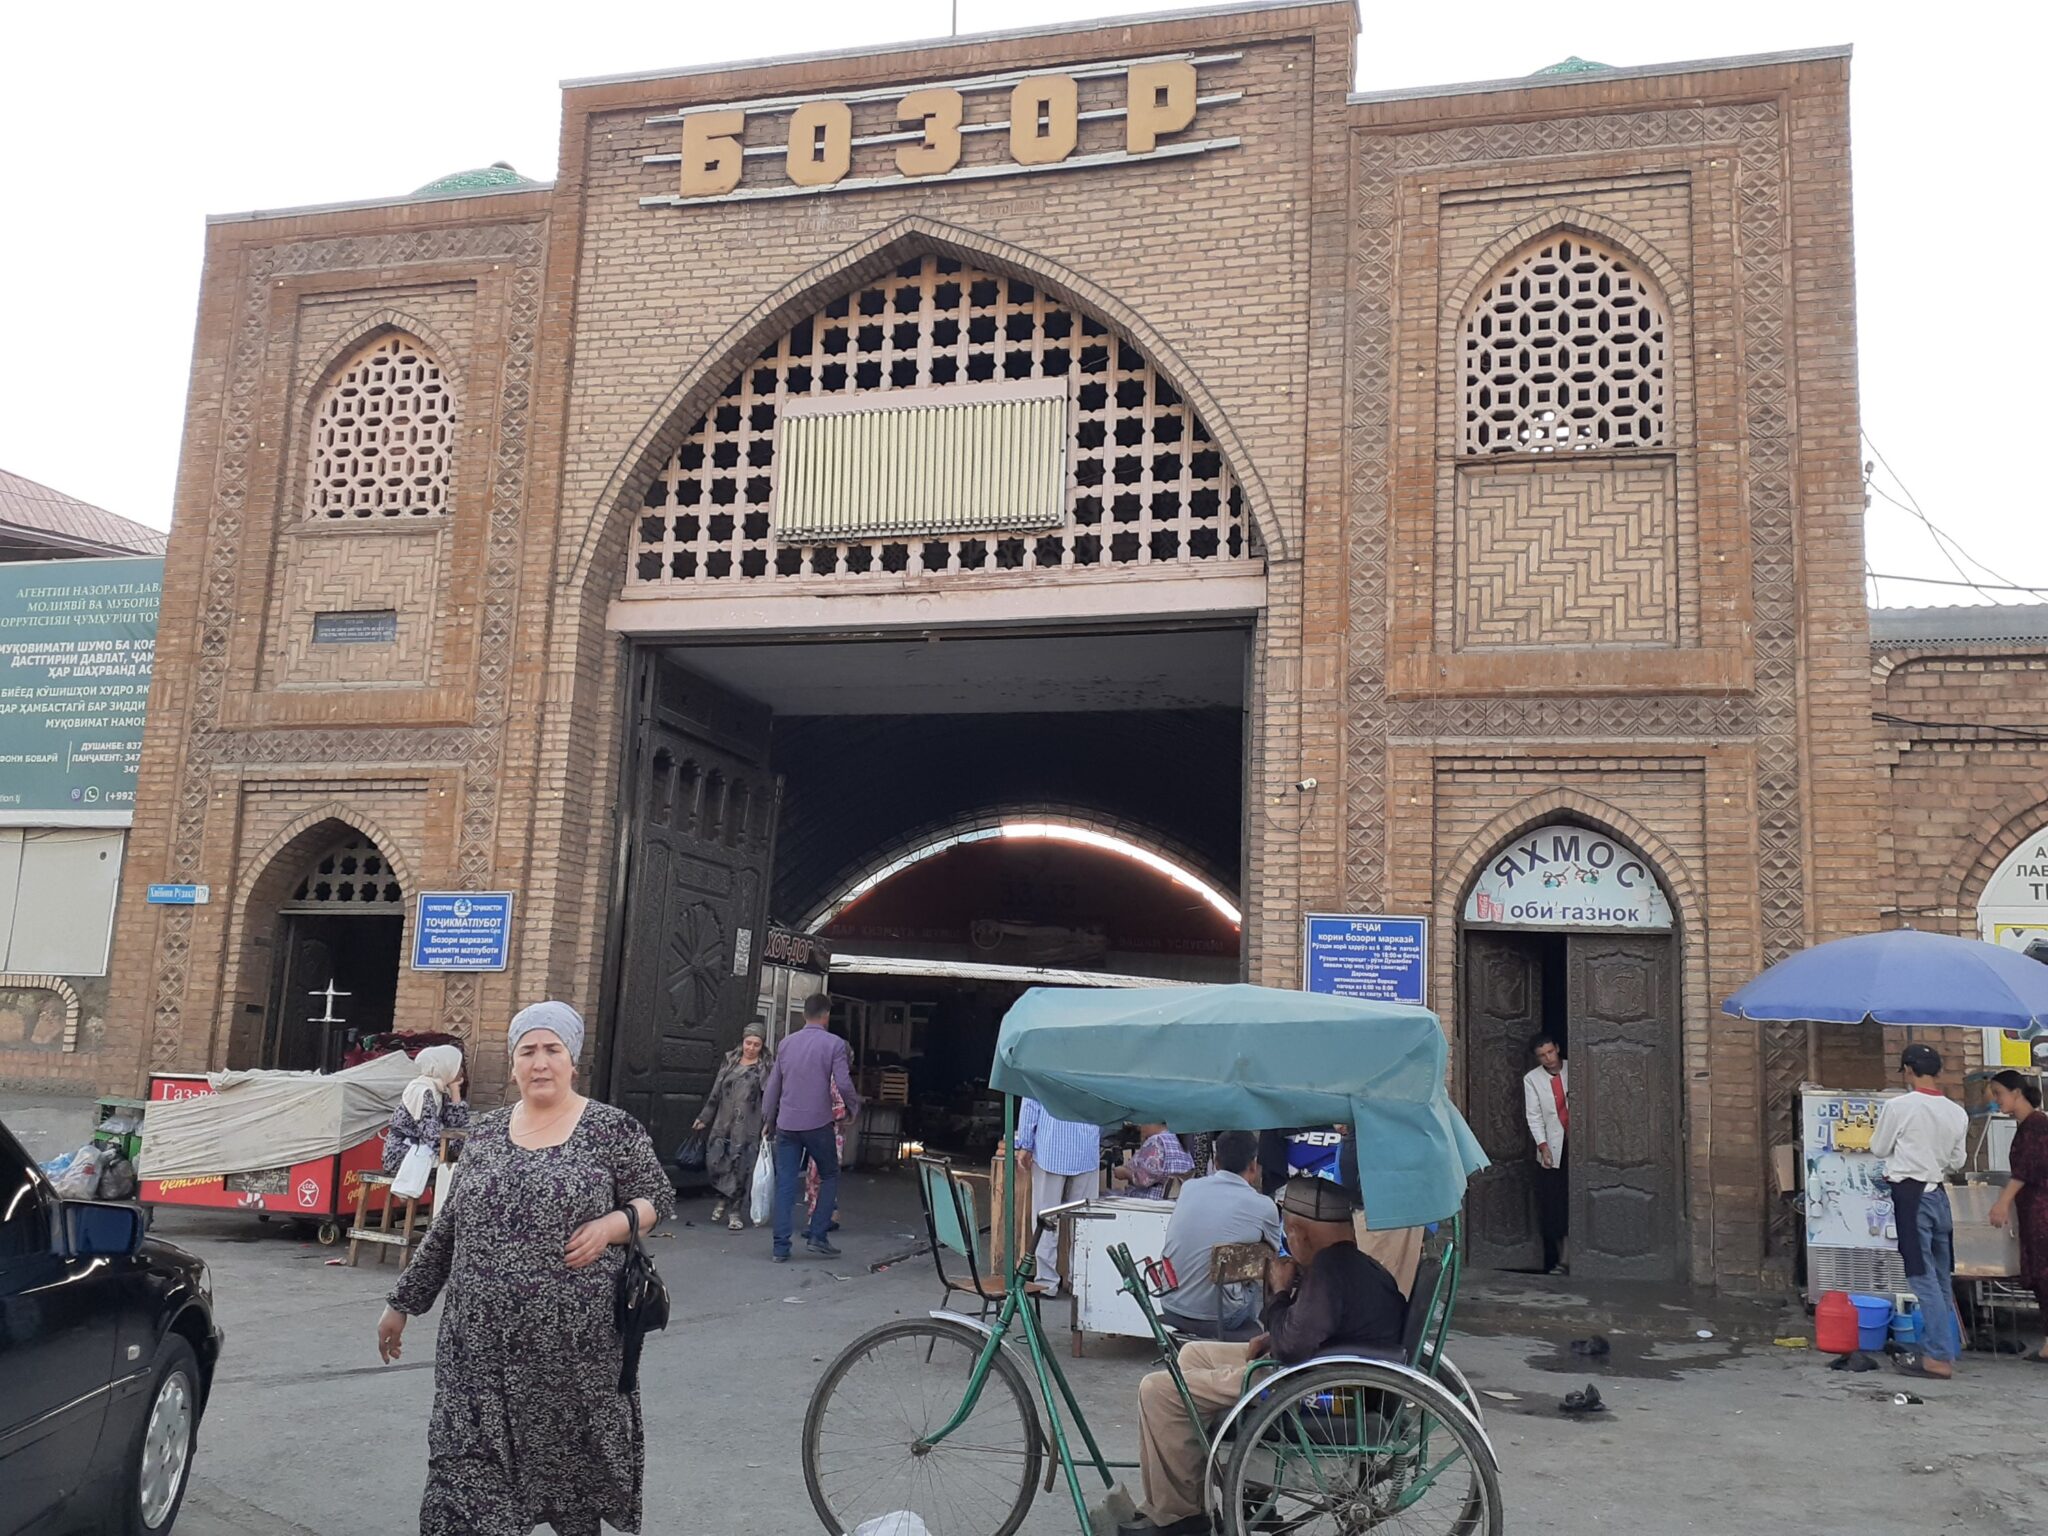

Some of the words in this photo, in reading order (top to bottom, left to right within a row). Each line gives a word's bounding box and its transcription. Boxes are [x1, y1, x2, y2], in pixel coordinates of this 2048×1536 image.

[679, 60, 1198, 198] БОЗОР
[16, 586, 70, 598] АГЕНТИИ
[72, 583, 133, 596] НАЗОРАТИ
[135, 582, 162, 594] ДАВ
[89, 599, 102, 610] ВА
[106, 597, 160, 609] МУБОРИЗ
[77, 640, 113, 652] ШУМО
[115, 639, 130, 650] БА
[10, 653, 78, 668] ДАСТГИРИИ
[79, 652, 128, 666] ДАВЛАТ,
[47, 666, 71, 679] ҲАР
[72, 664, 136, 678] ШАҲРВАНД
[1, 686, 34, 698] БИЁЕД
[99, 685, 133, 696] ХУДРО
[136, 684, 150, 694] ЯК
[0, 703, 17, 714] ДАР
[87, 702, 107, 712] БАР
[109, 701, 146, 712] ЗИДДИ
[81, 742, 124, 752] ДУШАНБЕ:
[126, 742, 142, 751] 837
[124, 753, 141, 762] 347
[123, 765, 139, 773] 347
[1494, 835, 1645, 889] ЯХМОС
[2029, 883, 2048, 900] Т
[1510, 901, 1553, 919] оби
[1561, 905, 1639, 922] газнок
[425, 918, 502, 928] ТОҶИКМАТЛУБОТ
[1345, 933, 1376, 943] бозори
[764, 931, 814, 966] ХОТ-ДОГ
[1815, 1104, 1839, 1117] CE
